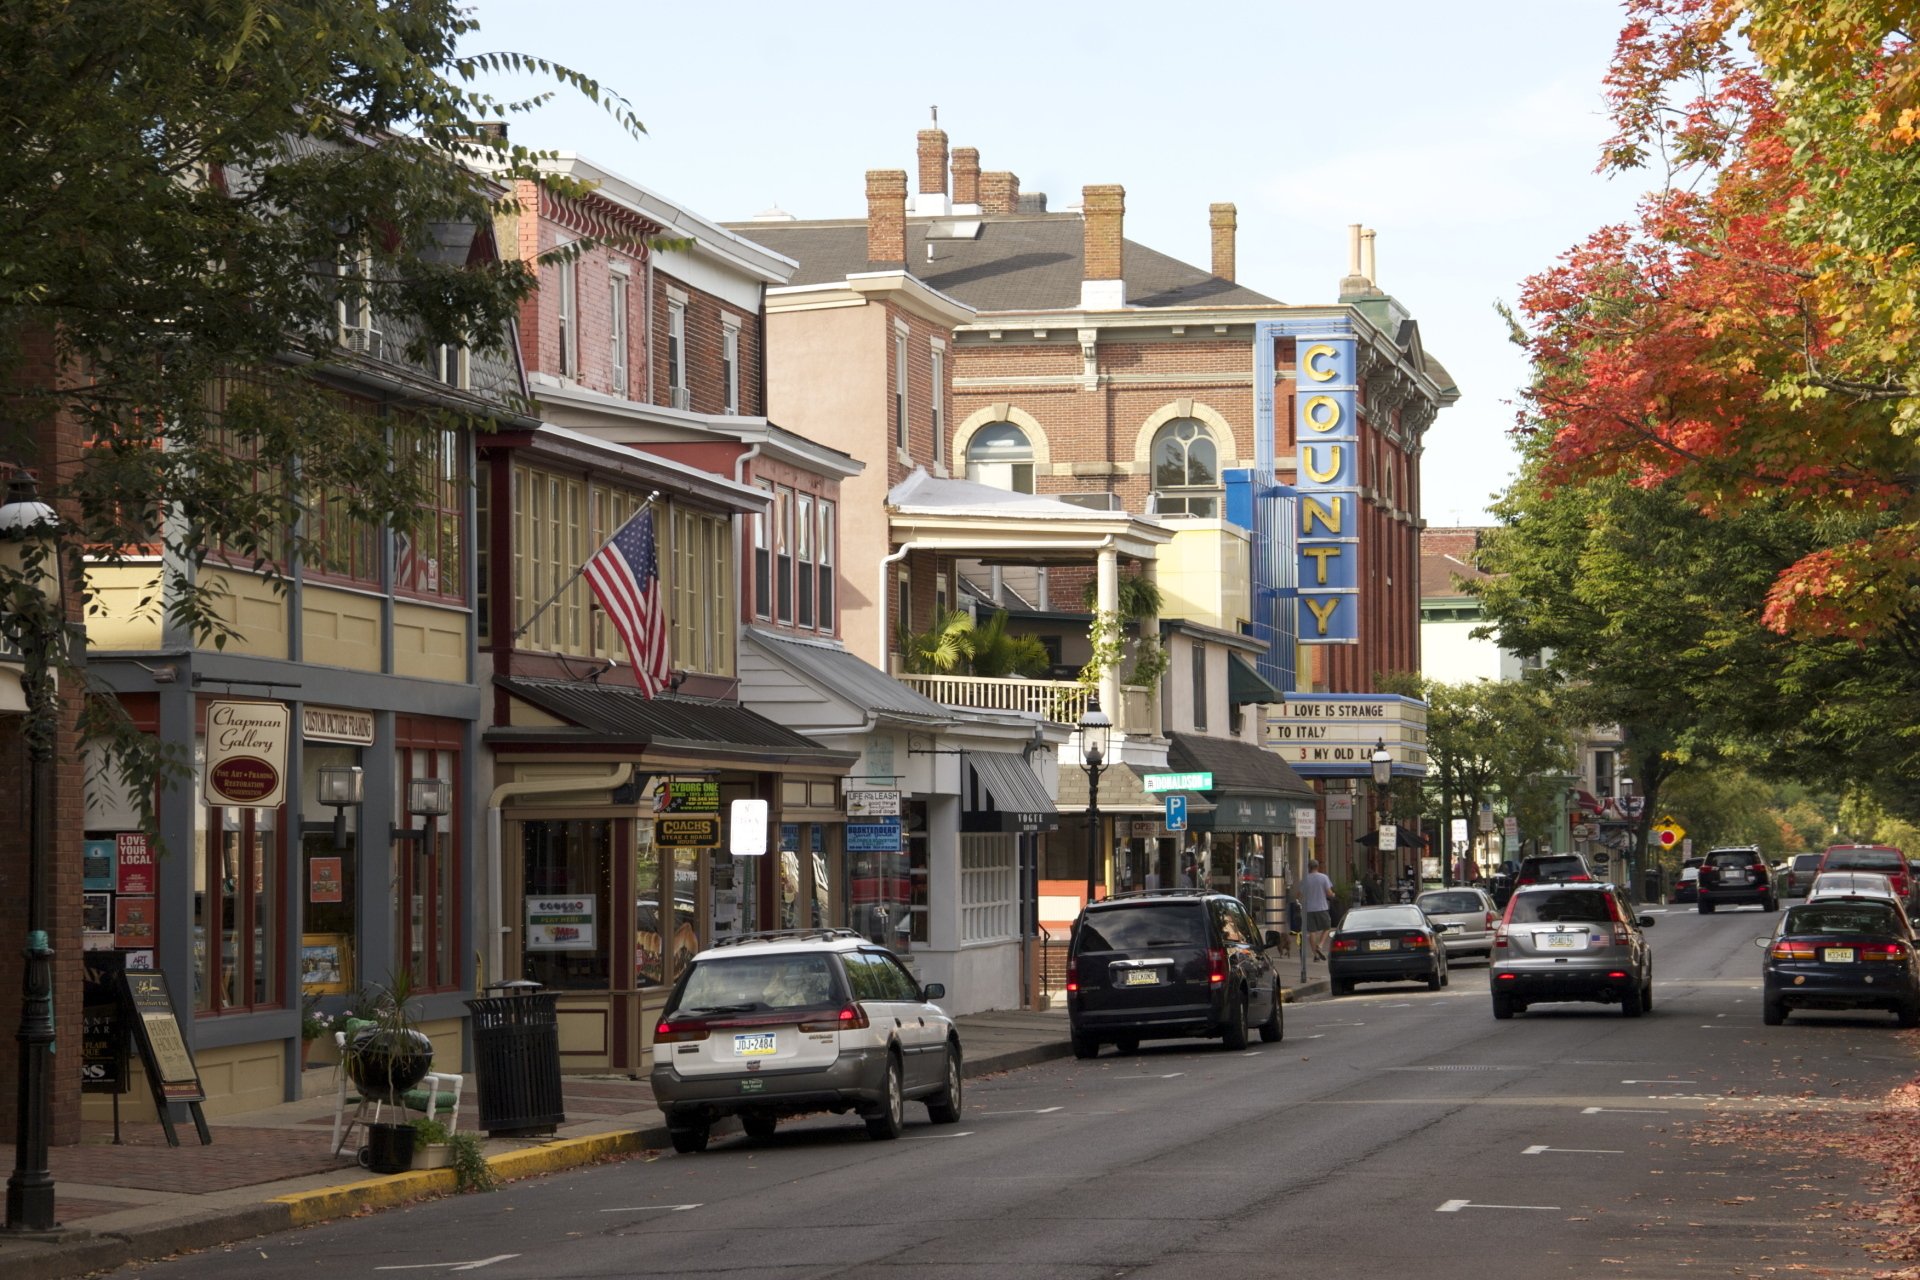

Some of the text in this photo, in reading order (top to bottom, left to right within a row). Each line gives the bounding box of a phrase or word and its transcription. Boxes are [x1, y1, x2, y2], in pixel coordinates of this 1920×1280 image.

[1303, 343, 1341, 636] COUNTY
[1294, 705, 1320, 716] LOVE
[1326, 705, 1335, 716] IS
[1338, 705, 1384, 716] STRANGE
[213, 706, 282, 731] Chapman
[304, 710, 370, 738] CUSTOM PICTURE FRAMING
[1278, 726, 1291, 738] TO
[1296, 726, 1326, 738] ITALY
[219, 728, 273, 752] Gallery
[1300, 748, 1307, 760] 3
[1314, 748, 1328, 760] MY
[1334, 748, 1354, 760] OLD
[224, 778, 265, 788] RESTORATION
[670, 783, 719, 792] CYBORG ONE
[1155, 774, 1203, 790] DONALDSON
[1170, 798, 1182, 816] P
[1018, 814, 1043, 823] VOGUE
[120, 836, 146, 845] LOVE
[120, 846, 147, 855] YOUR
[120, 855, 152, 865] LOCAL
[132, 956, 147, 964] ART
[148, 1020, 176, 1036] HAPPY
[155, 1036, 182, 1052] HOUR
